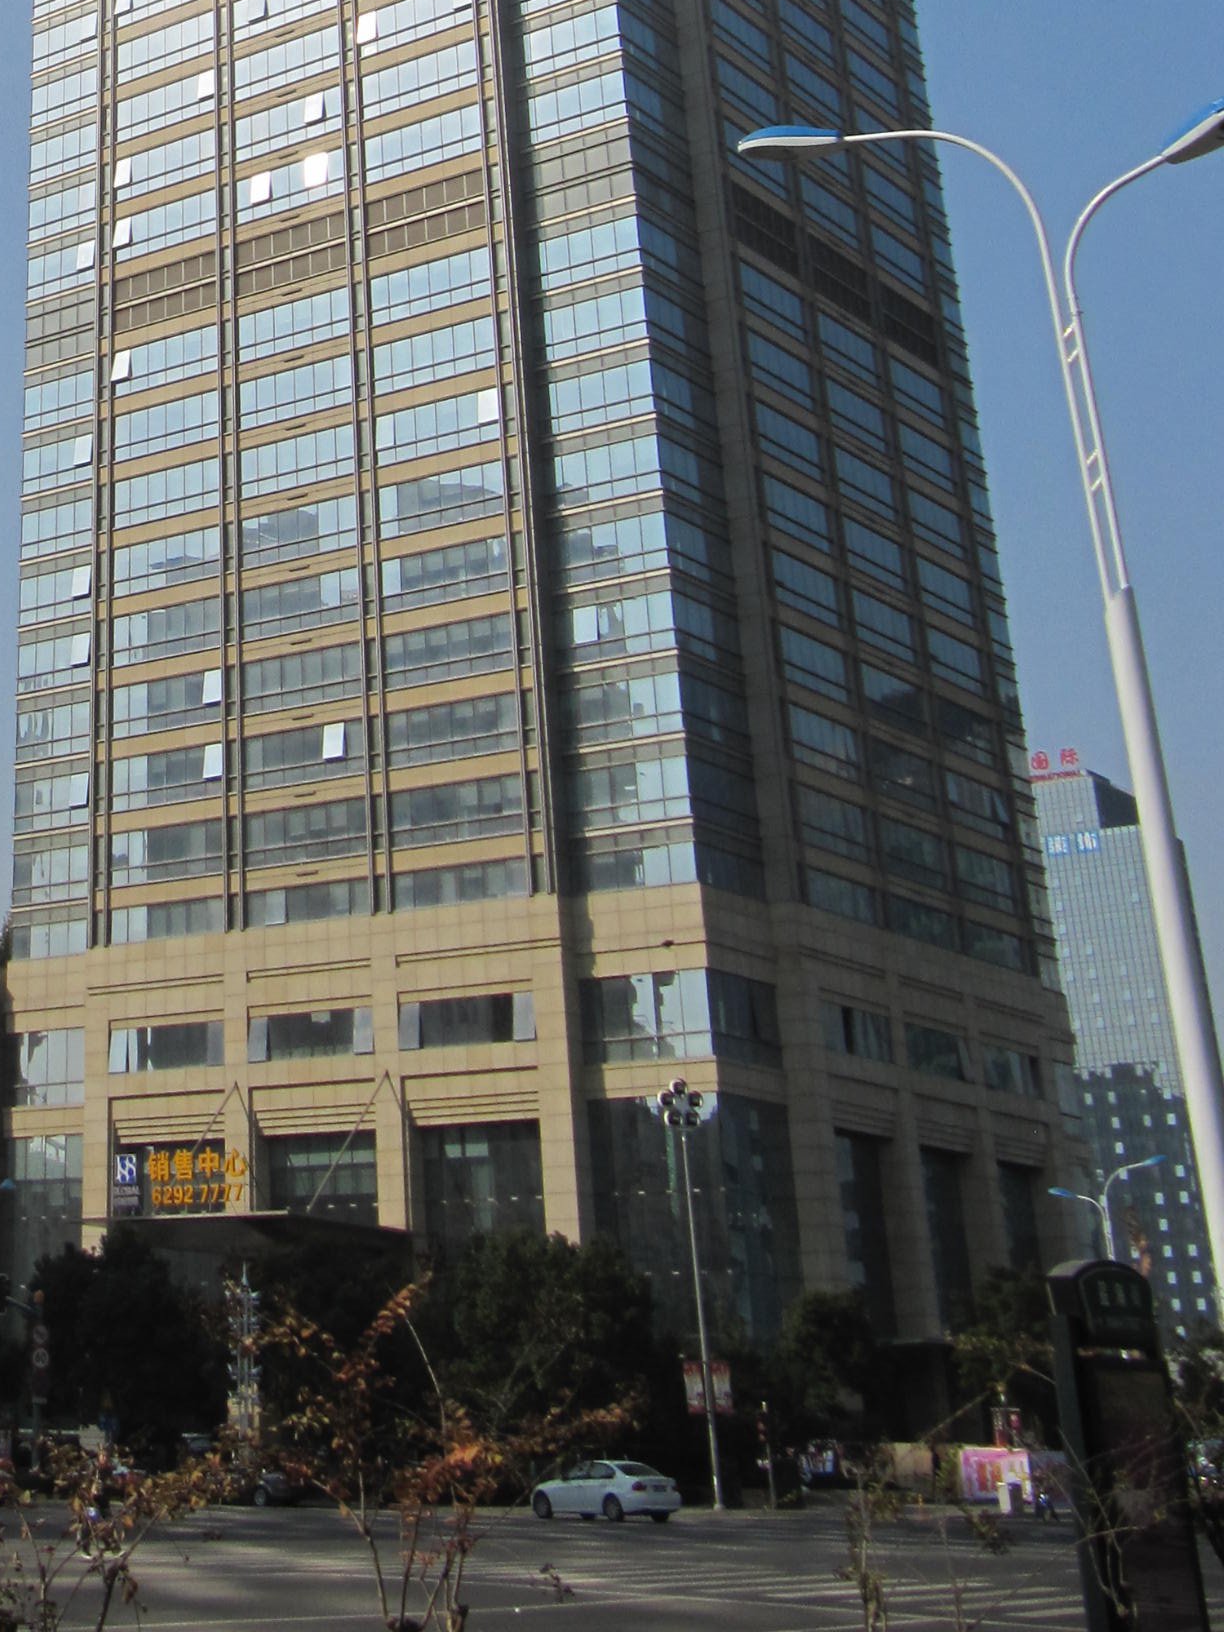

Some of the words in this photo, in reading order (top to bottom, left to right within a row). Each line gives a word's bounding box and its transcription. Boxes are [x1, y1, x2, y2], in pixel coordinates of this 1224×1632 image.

[148, 1146, 249, 1182] 销售中心
[151, 1185, 193, 1205] 6292
[199, 1183, 243, 1204] 7777
